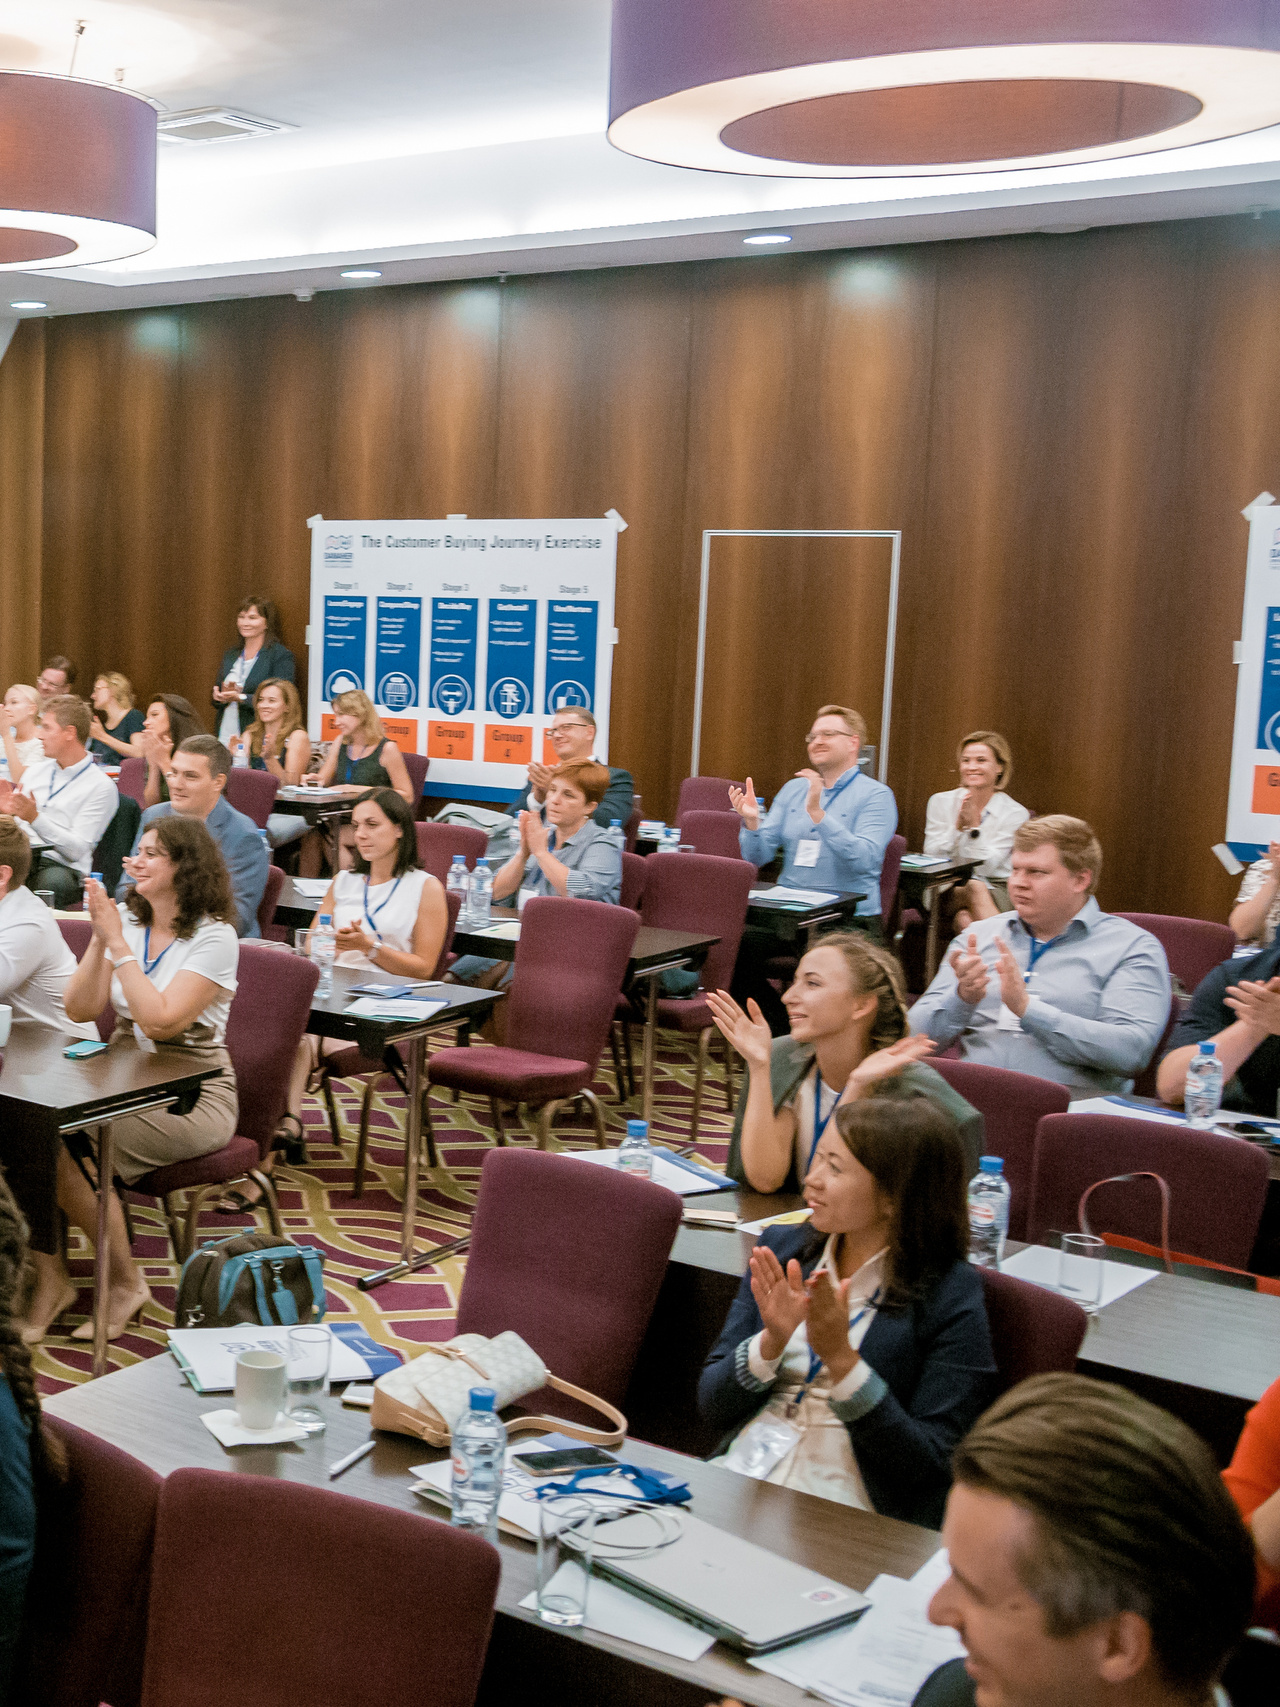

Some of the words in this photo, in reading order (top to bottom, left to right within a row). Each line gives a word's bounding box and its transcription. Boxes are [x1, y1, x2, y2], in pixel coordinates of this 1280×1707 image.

[361, 535, 382, 548] The
[385, 535, 441, 548] Customer
[444, 535, 486, 551] Buying
[490, 535, 541, 551] Journey
[544, 534, 602, 548] Exercise
[333, 581, 353, 591] Stage
[386, 582, 407, 592] Stage
[442, 583, 462, 593] Stage
[500, 584, 521, 594] Stage
[559, 584, 581, 595] Stage
[435, 725, 466, 740] Group
[492, 729, 524, 744] Group
[446, 744, 454, 755] 3
